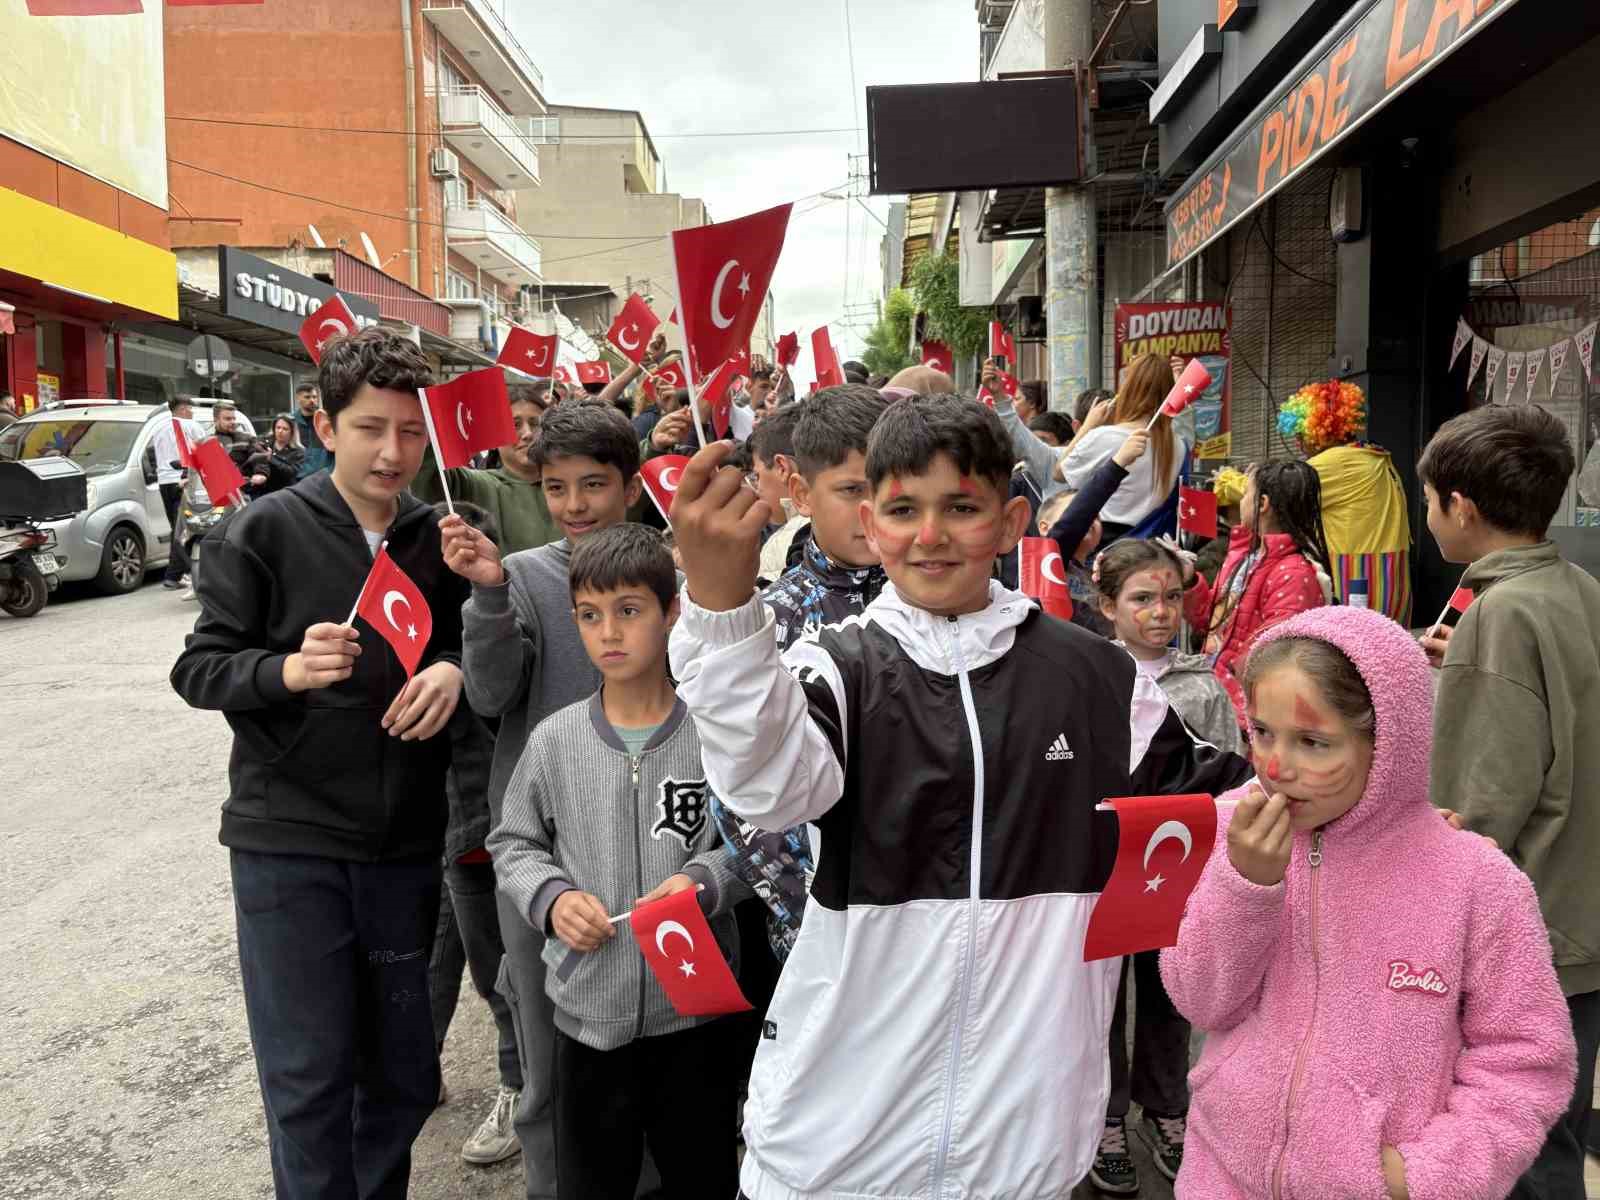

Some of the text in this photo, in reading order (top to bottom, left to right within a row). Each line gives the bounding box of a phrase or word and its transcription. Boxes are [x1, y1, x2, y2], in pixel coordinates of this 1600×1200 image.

[1384, 0, 1495, 90] LA
[235, 272, 323, 316] STÜDYO
[1128, 305, 1228, 340] DOYURAN
[1122, 332, 1222, 362] KAMPANYA
[1388, 961, 1449, 994] Barbie
